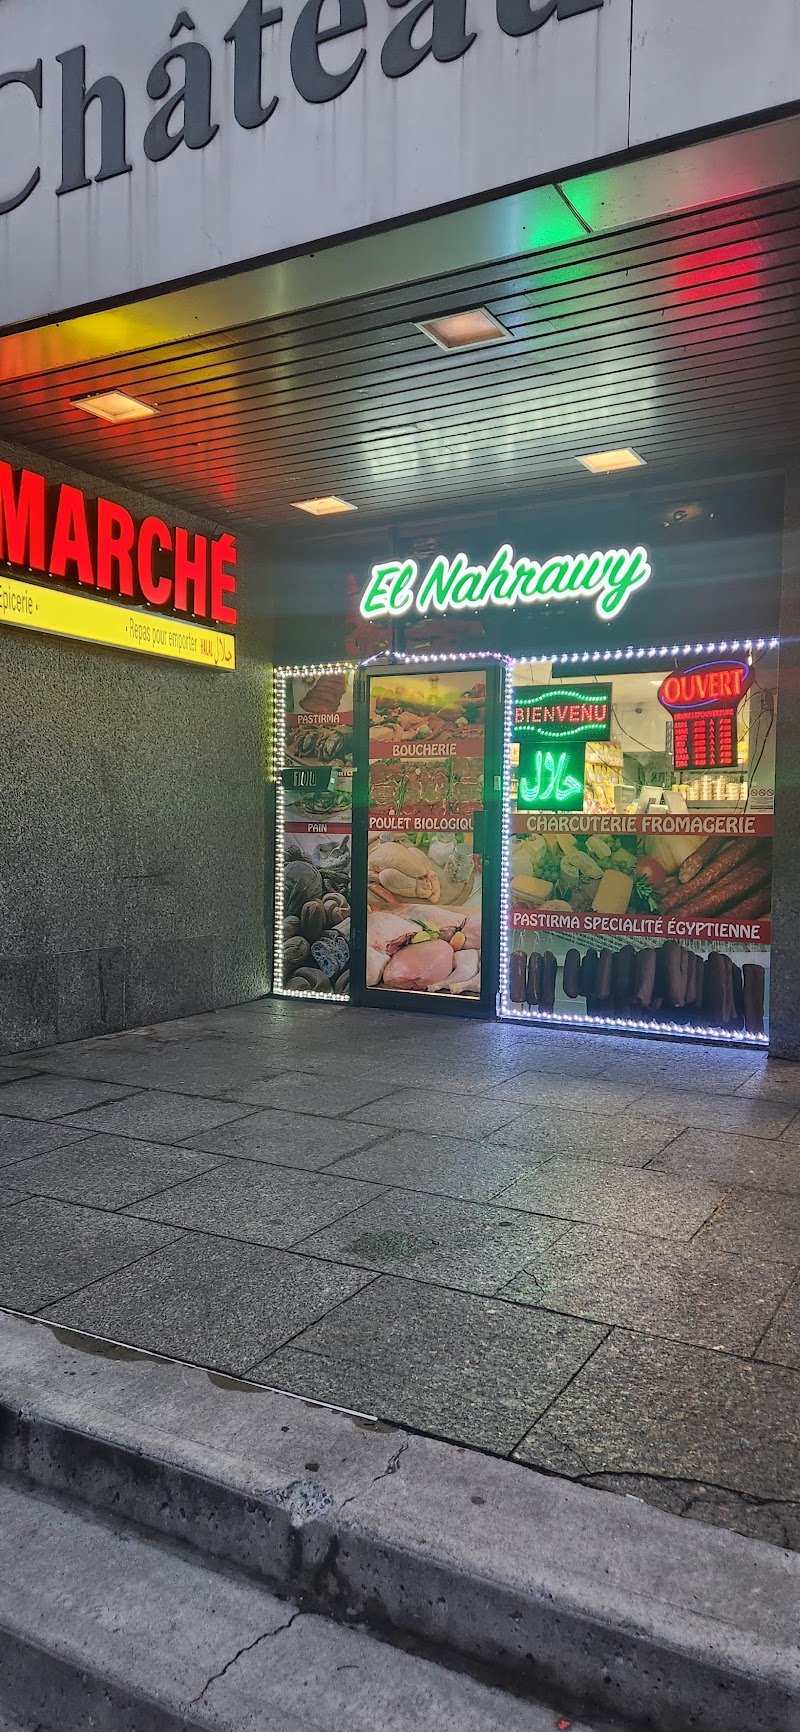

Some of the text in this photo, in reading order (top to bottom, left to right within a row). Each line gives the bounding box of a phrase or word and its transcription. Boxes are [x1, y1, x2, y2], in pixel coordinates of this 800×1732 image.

[0, 460, 238, 625] MARCHÉ
[362, 547, 649, 615] El Nahrawy
[129, 618, 213, 657] Repas pour emporter HALAL
[664, 668, 745, 703] OUVERT
[297, 712, 340, 725] PASTIRMA
[514, 703, 608, 723] BIENVENU
[391, 743, 457, 757] BOUCHERIE
[519, 750, 584, 802] حلال
[307, 823, 328, 833] PAIN
[369, 816, 474, 832] POULET BIOLOGIQU
[526, 815, 756, 834] CHARCUTERIE FROMAGERIE
[513, 912, 761, 940] PASTIRMA SPECIALITÉ ÉGYPTIENNE
